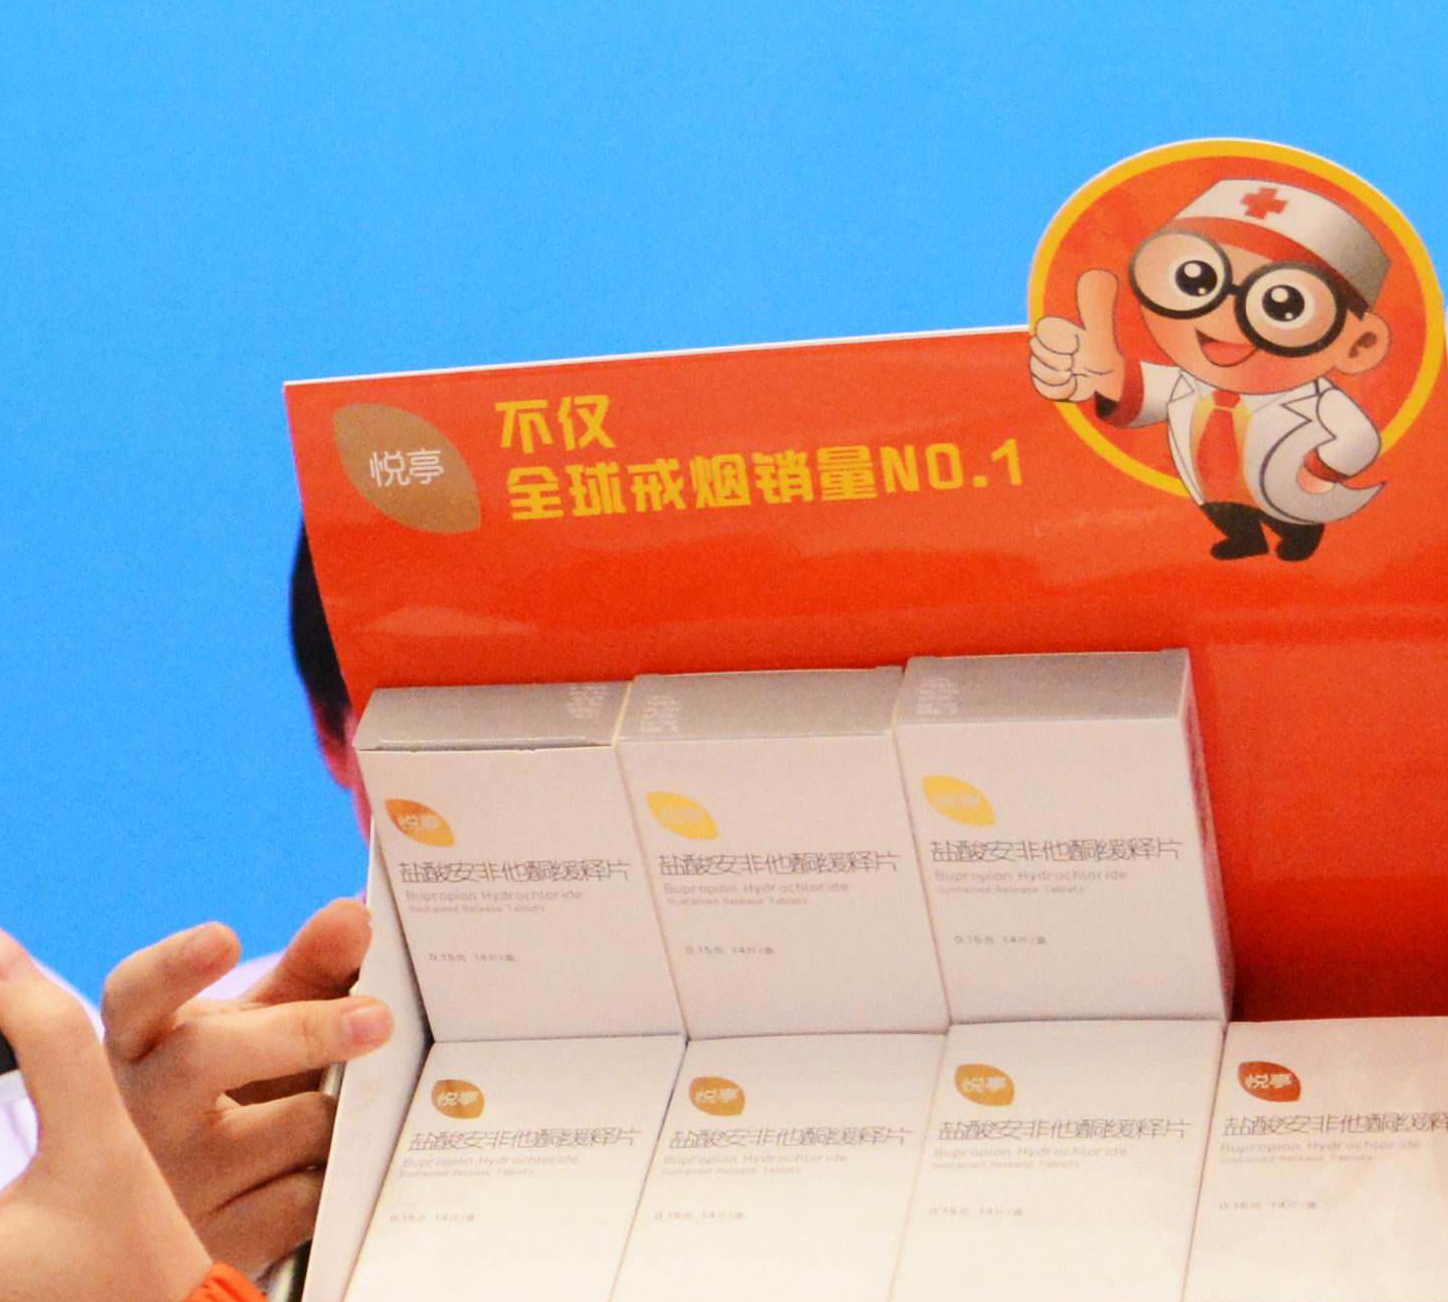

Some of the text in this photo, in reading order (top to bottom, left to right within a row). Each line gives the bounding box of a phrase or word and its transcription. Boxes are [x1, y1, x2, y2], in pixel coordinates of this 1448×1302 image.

[495, 395, 615, 453] 不仅
[369, 449, 444, 487] 悦亭
[508, 438, 1024, 521] 全球戒烟销量NO.1
